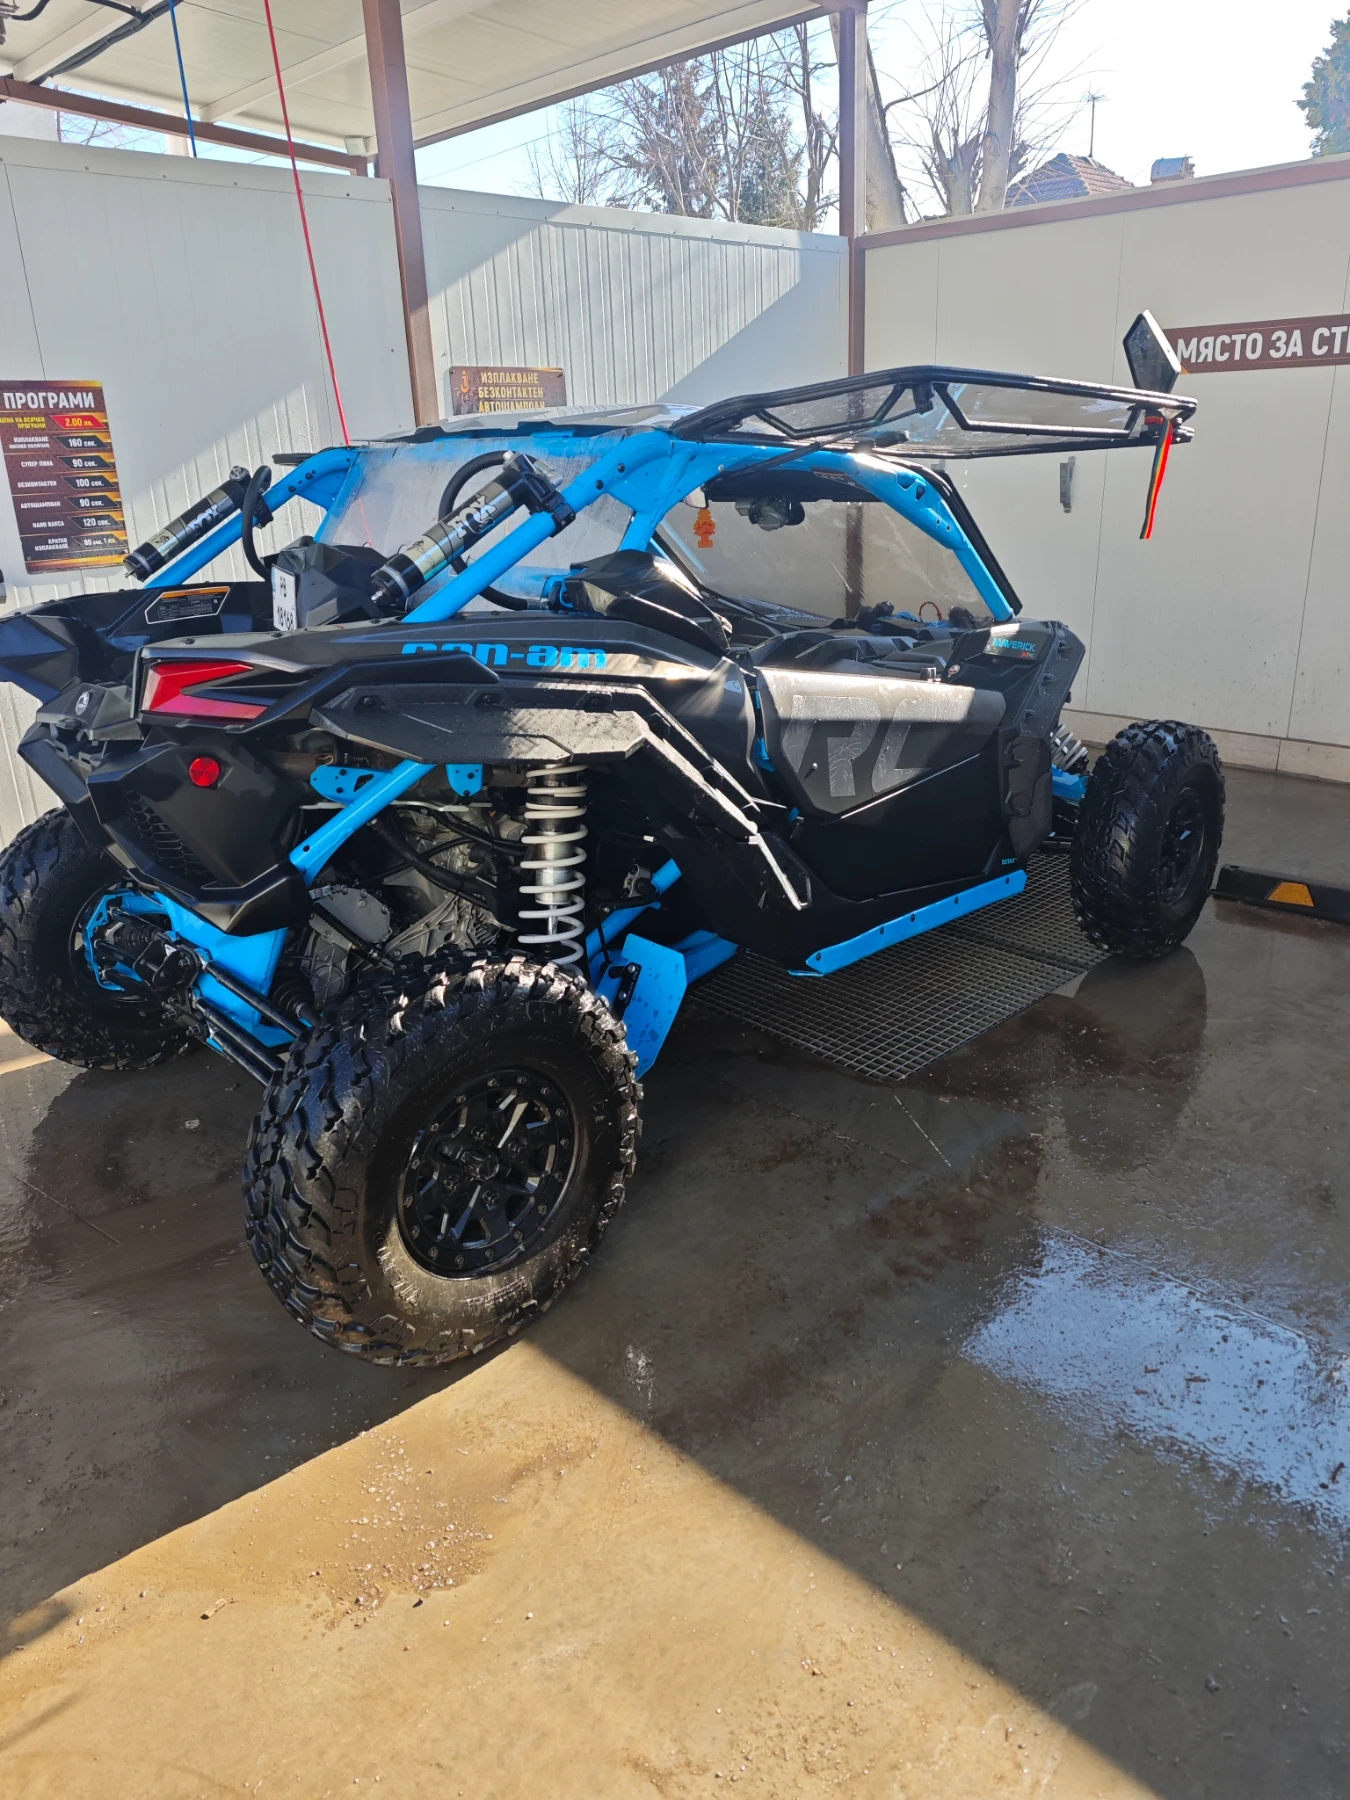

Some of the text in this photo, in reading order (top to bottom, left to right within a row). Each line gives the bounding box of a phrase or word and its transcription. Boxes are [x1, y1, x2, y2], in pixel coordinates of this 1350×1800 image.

[1177, 333, 1263, 363] МЯСТО
[1269, 329, 1303, 359] ЗА
[481, 371, 539, 384] ИЗПЛАКВАНЕ
[478, 387, 544, 399] БЕЗКОНТАКТЕН
[3, 392, 95, 409] ПРОГРАМИ
[64, 418, 82, 427] 2.00
[68, 438, 82, 447] 160
[72, 458, 82, 467] 90
[75, 478, 89, 487] 100
[79, 498, 90, 507] 90
[447, 495, 497, 539] FOX
[83, 518, 96, 527] 120
[992, 637, 1036, 652] MAVERICK
